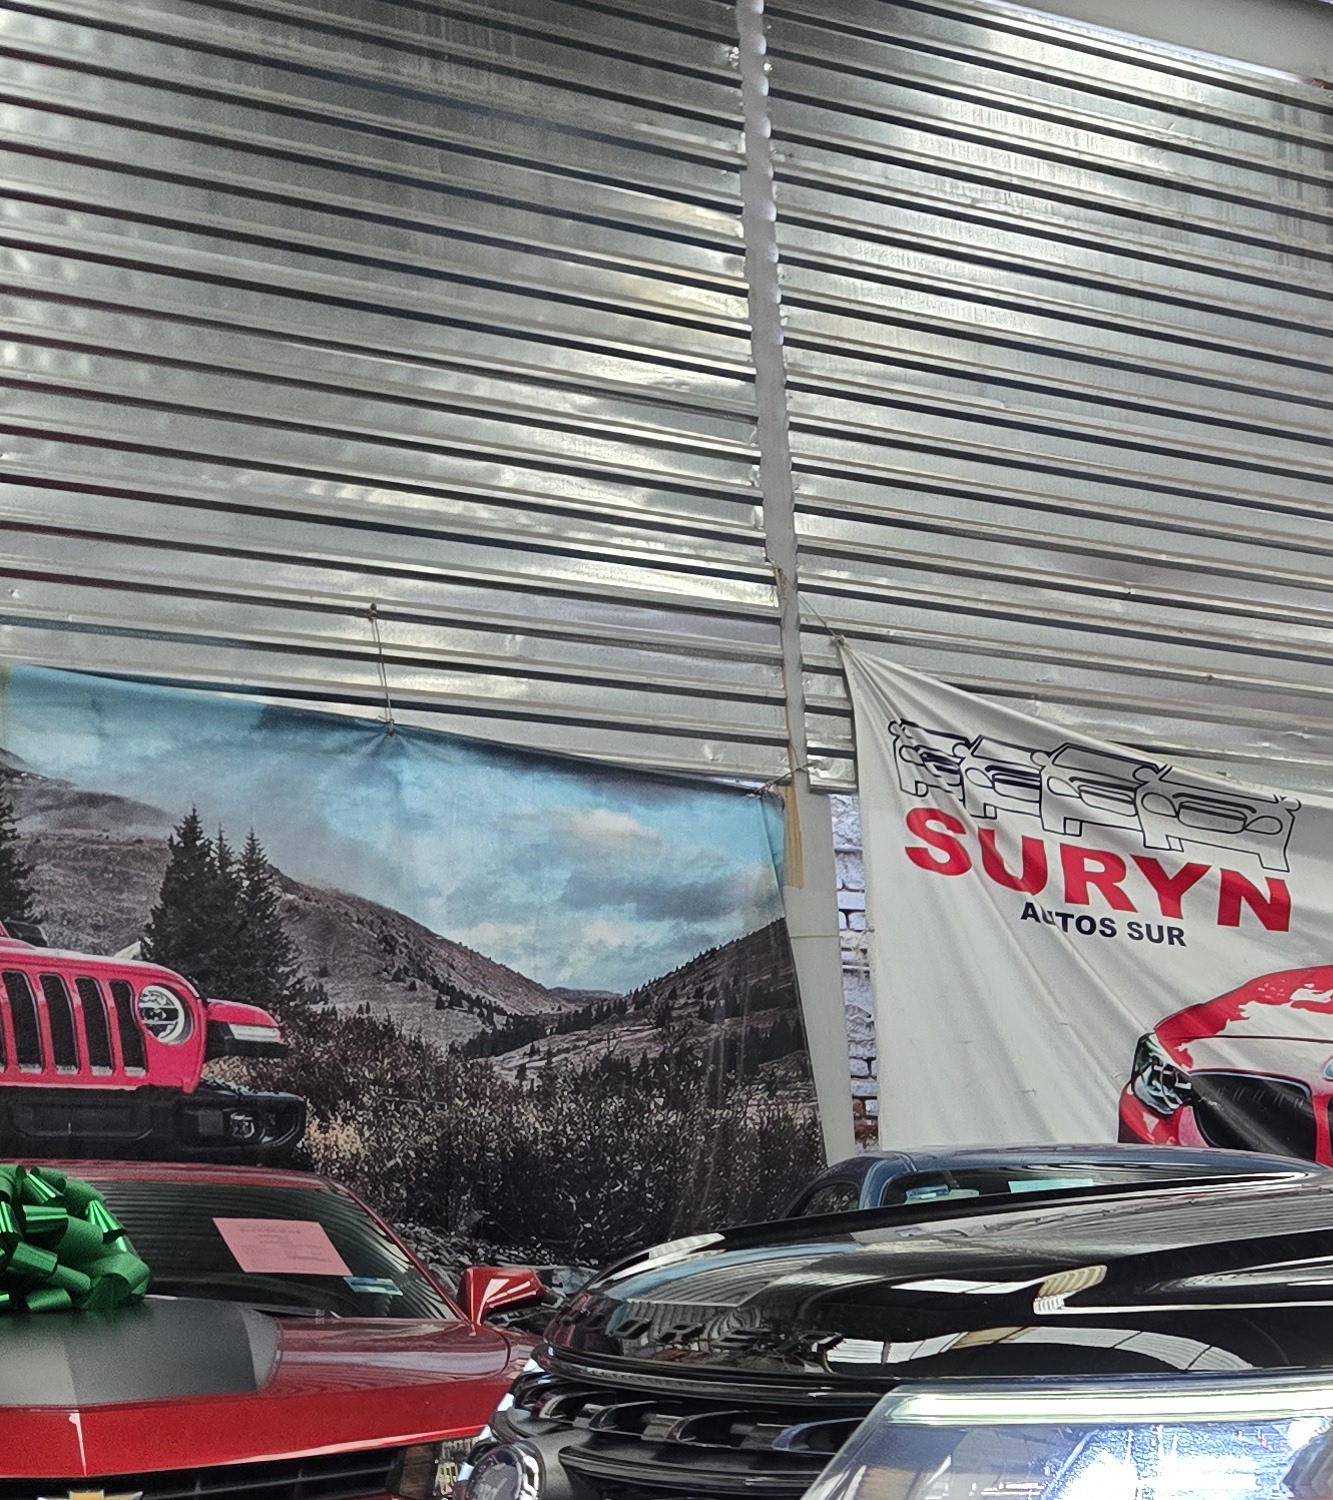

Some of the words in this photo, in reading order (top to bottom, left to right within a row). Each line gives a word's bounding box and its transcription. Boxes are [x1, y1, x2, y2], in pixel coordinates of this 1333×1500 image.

[905, 807, 1291, 932] SURYN
[1020, 901, 1118, 938] AUTOS
[1126, 921, 1188, 947] SUR
